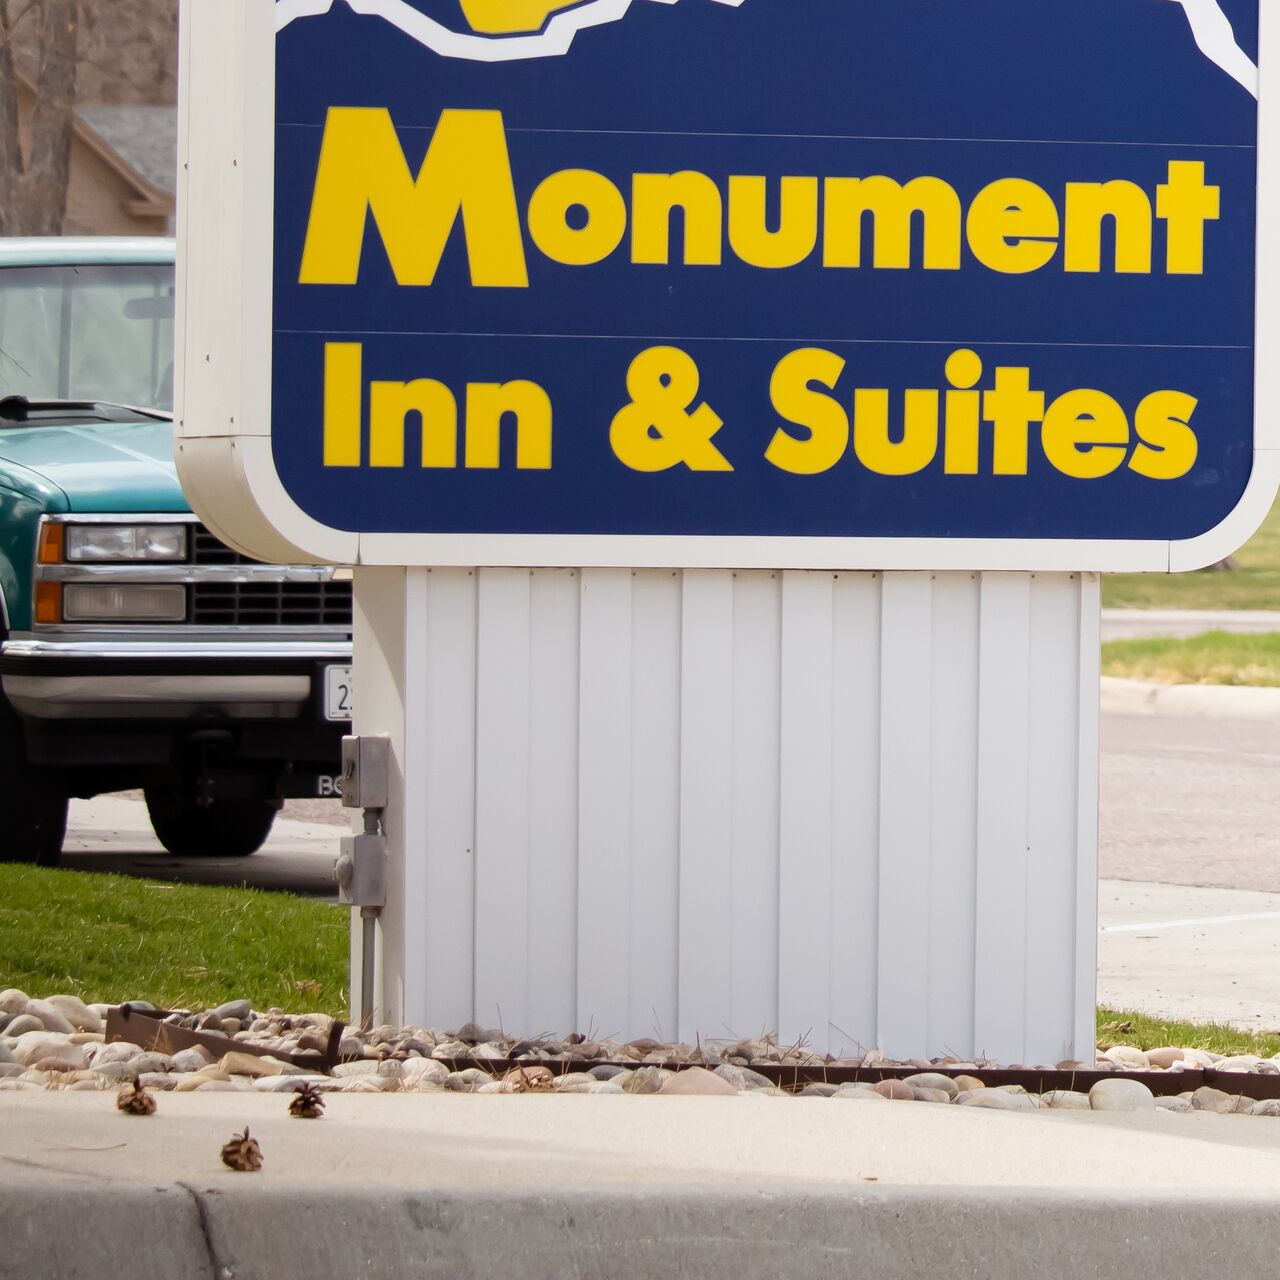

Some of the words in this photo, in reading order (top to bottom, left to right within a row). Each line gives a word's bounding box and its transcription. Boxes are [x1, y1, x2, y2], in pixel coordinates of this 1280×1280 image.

[298, 106, 1221, 289] Monument
[323, 342, 553, 470] Inn
[609, 345, 735, 473] &
[764, 348, 1199, 480] Suites
